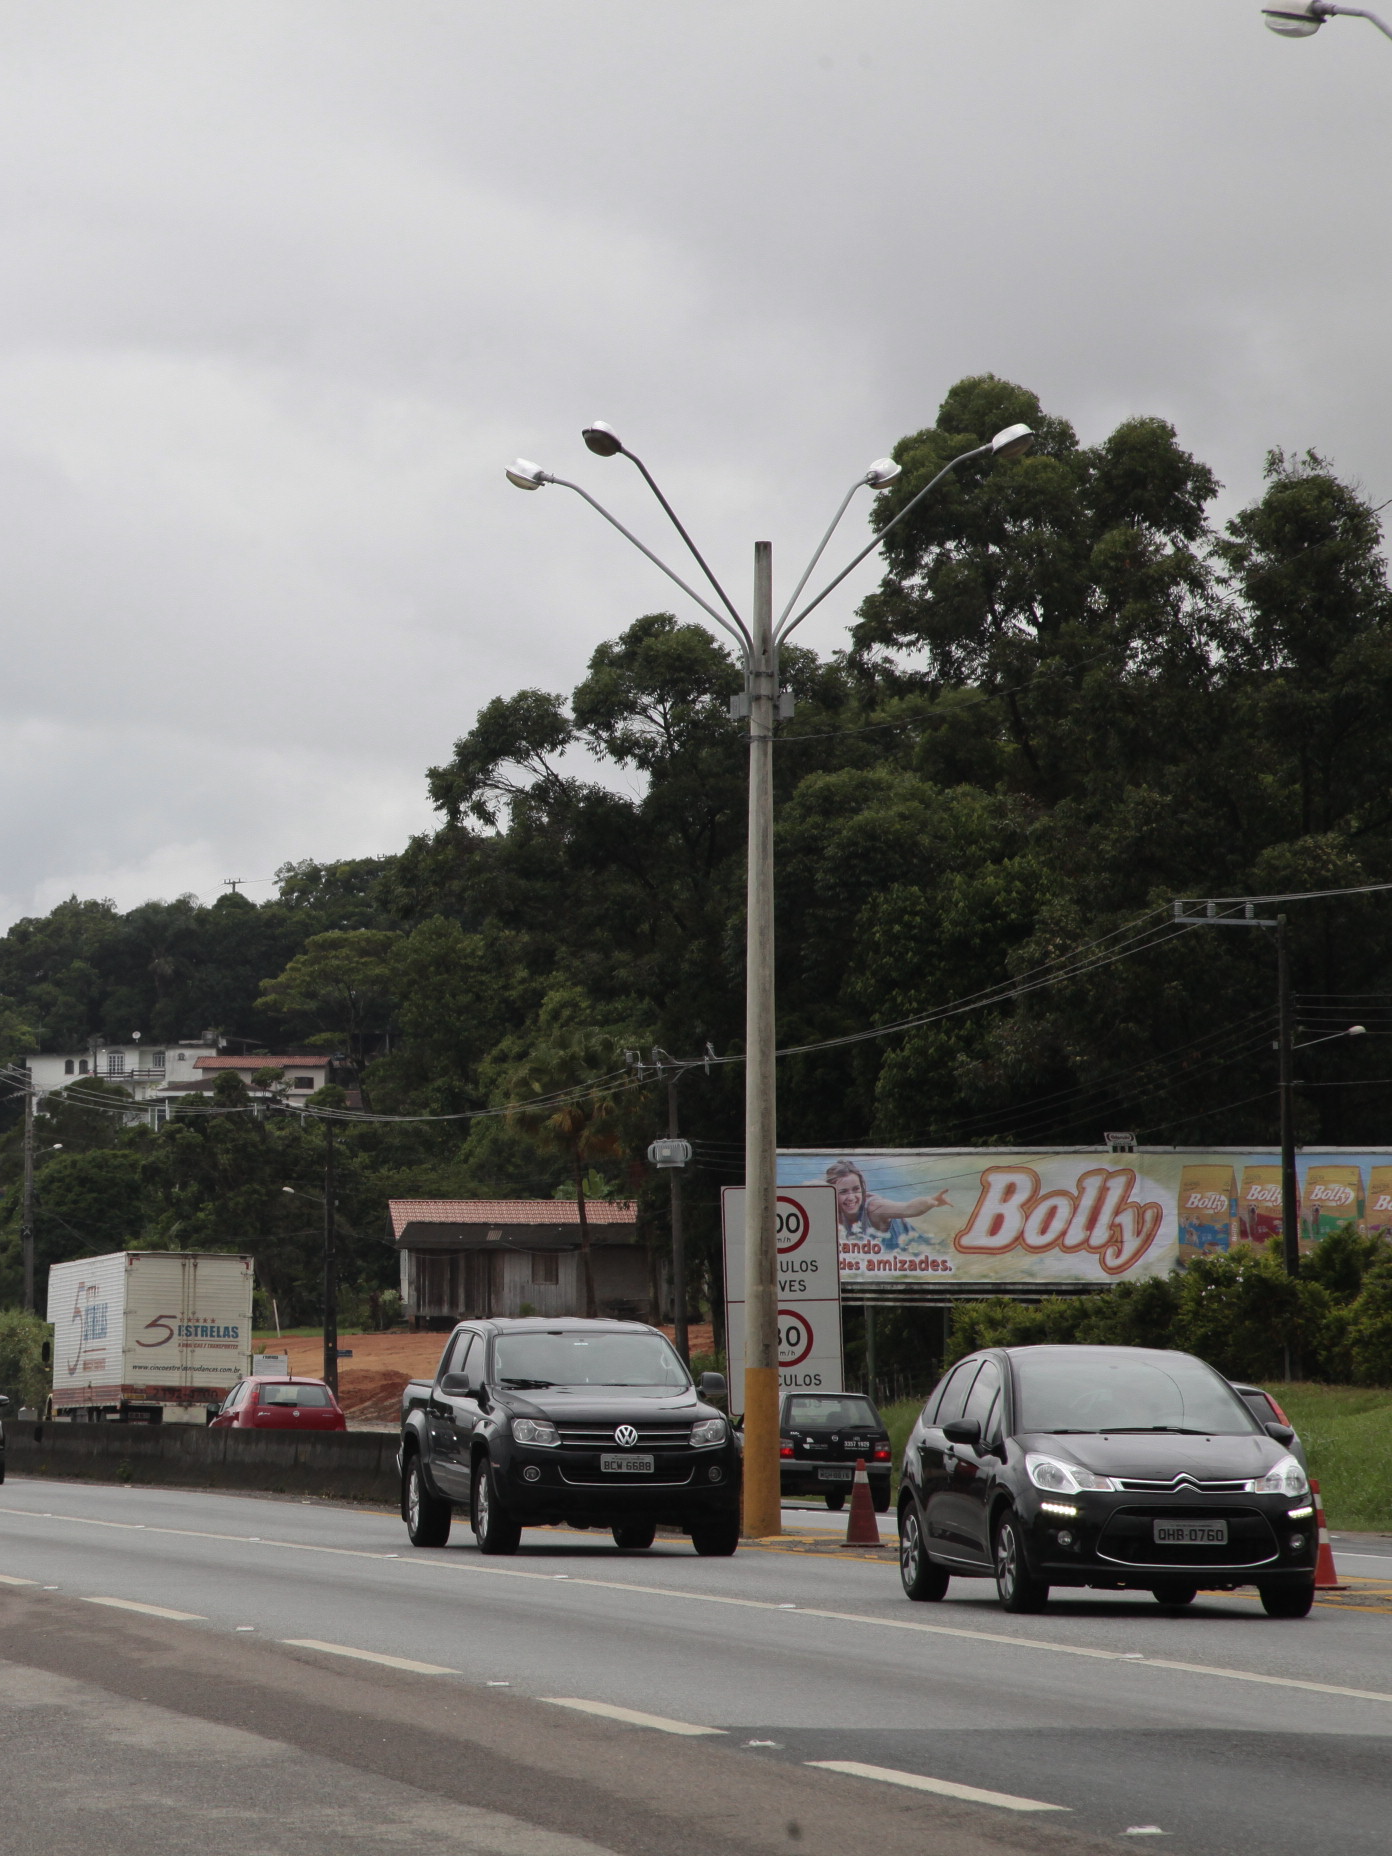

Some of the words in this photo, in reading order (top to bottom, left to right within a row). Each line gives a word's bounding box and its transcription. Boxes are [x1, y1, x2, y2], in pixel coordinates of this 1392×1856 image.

[1185, 1193, 1228, 1212] Bolly
[1310, 1185, 1353, 1206] Bolly
[953, 1165, 1164, 1276] Bolly
[780, 1260, 819, 1273] ULOS
[839, 1258, 861, 1271] des
[866, 1255, 953, 1272] amizades.
[779, 1280, 807, 1293] VES
[136, 1315, 177, 1347] 5
[177, 1325, 240, 1339] ESTRELAS
